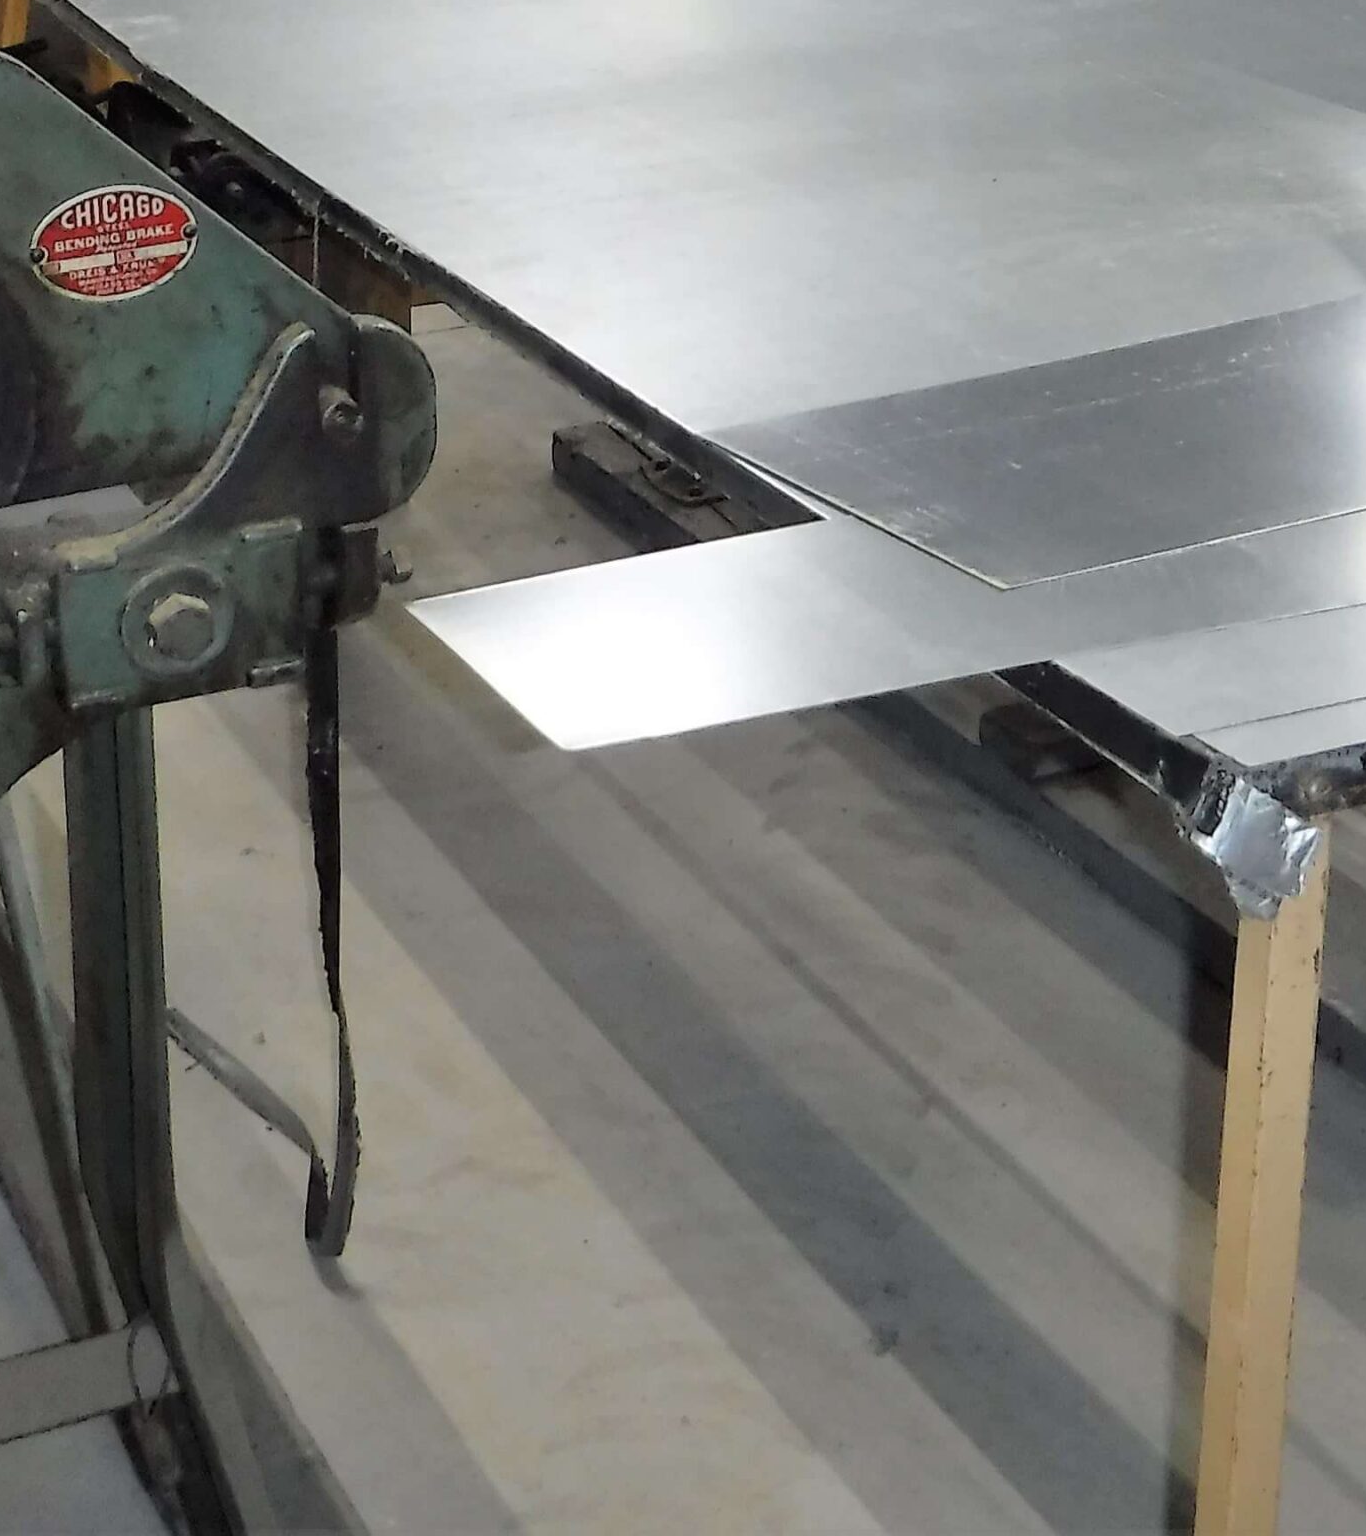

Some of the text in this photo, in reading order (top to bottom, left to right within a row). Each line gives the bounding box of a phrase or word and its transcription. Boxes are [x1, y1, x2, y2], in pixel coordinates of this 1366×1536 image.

[60, 193, 165, 229] CHICAGO
[54, 223, 175, 252] BENDING BRAKE
[69, 266, 106, 280] DREIS
